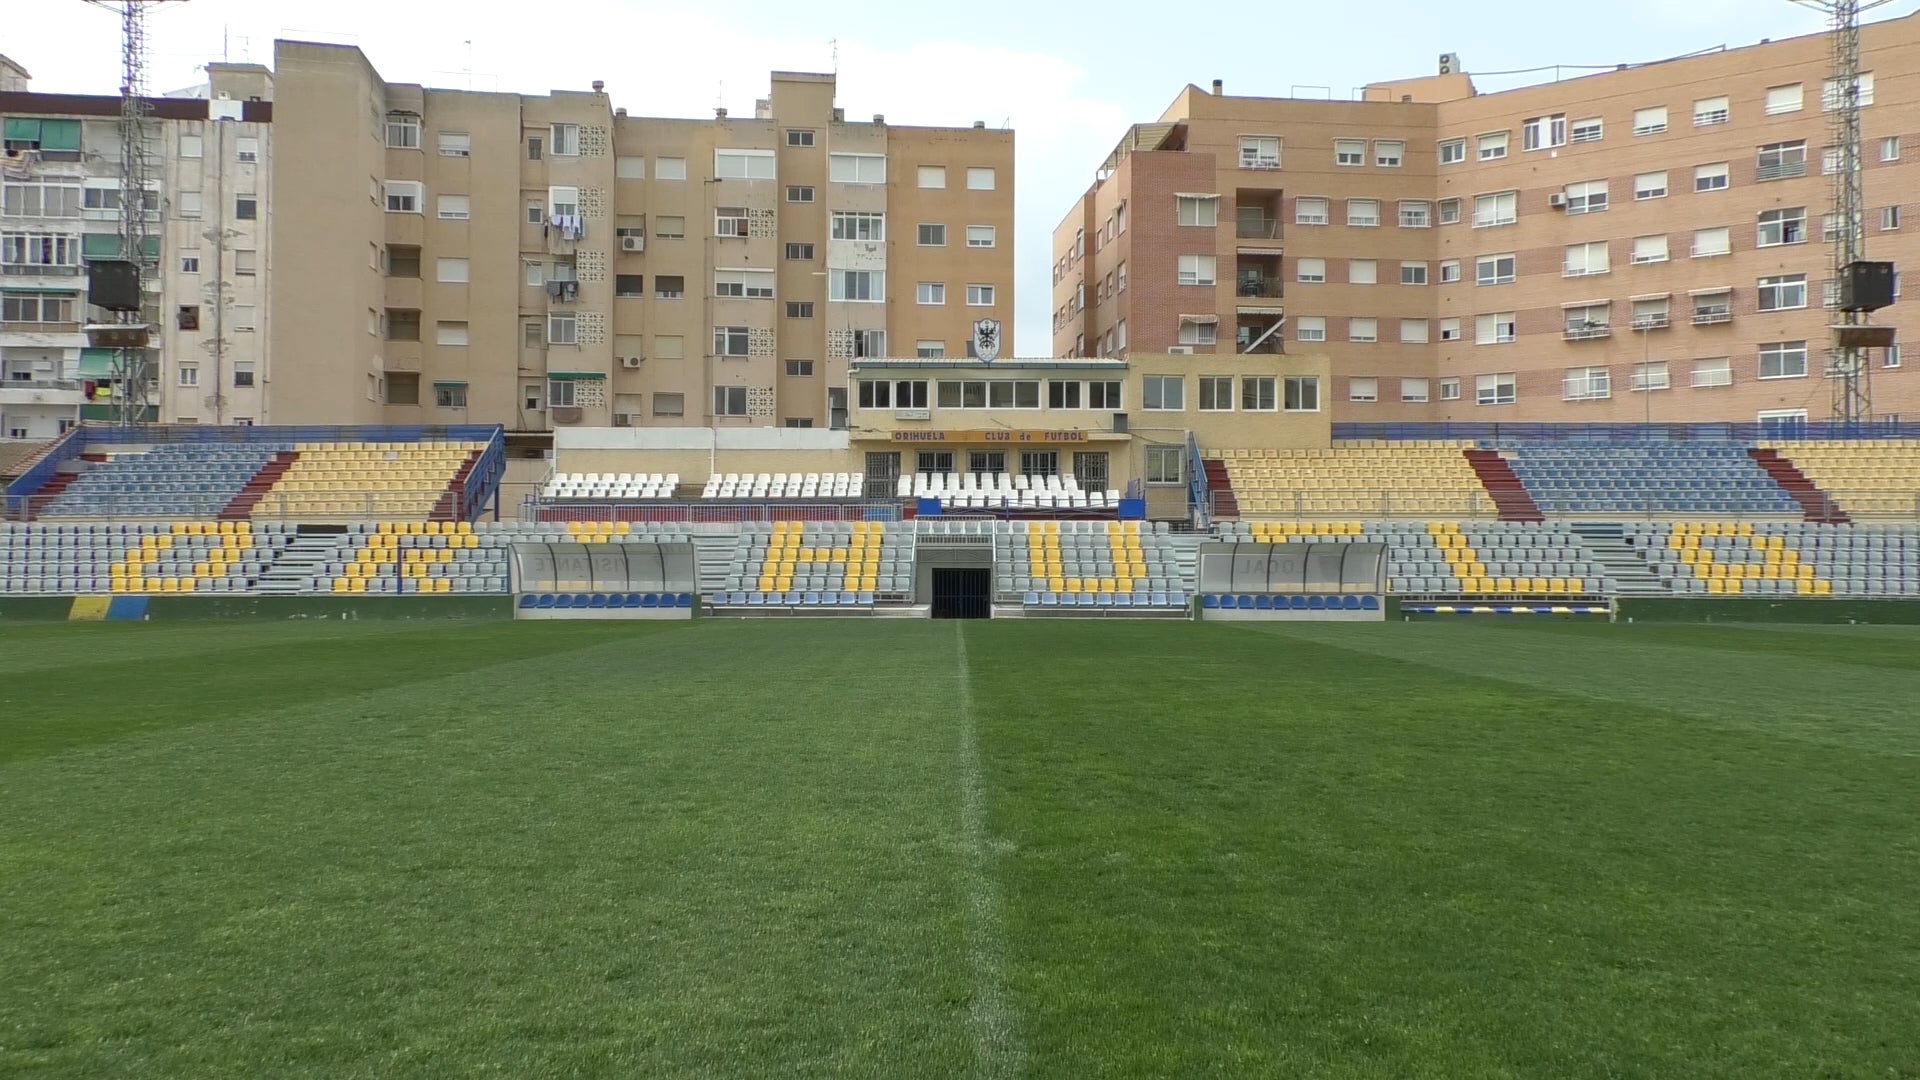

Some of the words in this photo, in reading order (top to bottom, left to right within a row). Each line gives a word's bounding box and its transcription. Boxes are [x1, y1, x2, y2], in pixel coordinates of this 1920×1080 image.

[895, 432, 945, 441] ORIHUELA
[985, 432, 1010, 441] CLUB
[1019, 432, 1031, 441] de
[1044, 432, 1083, 441] FUTBOL
